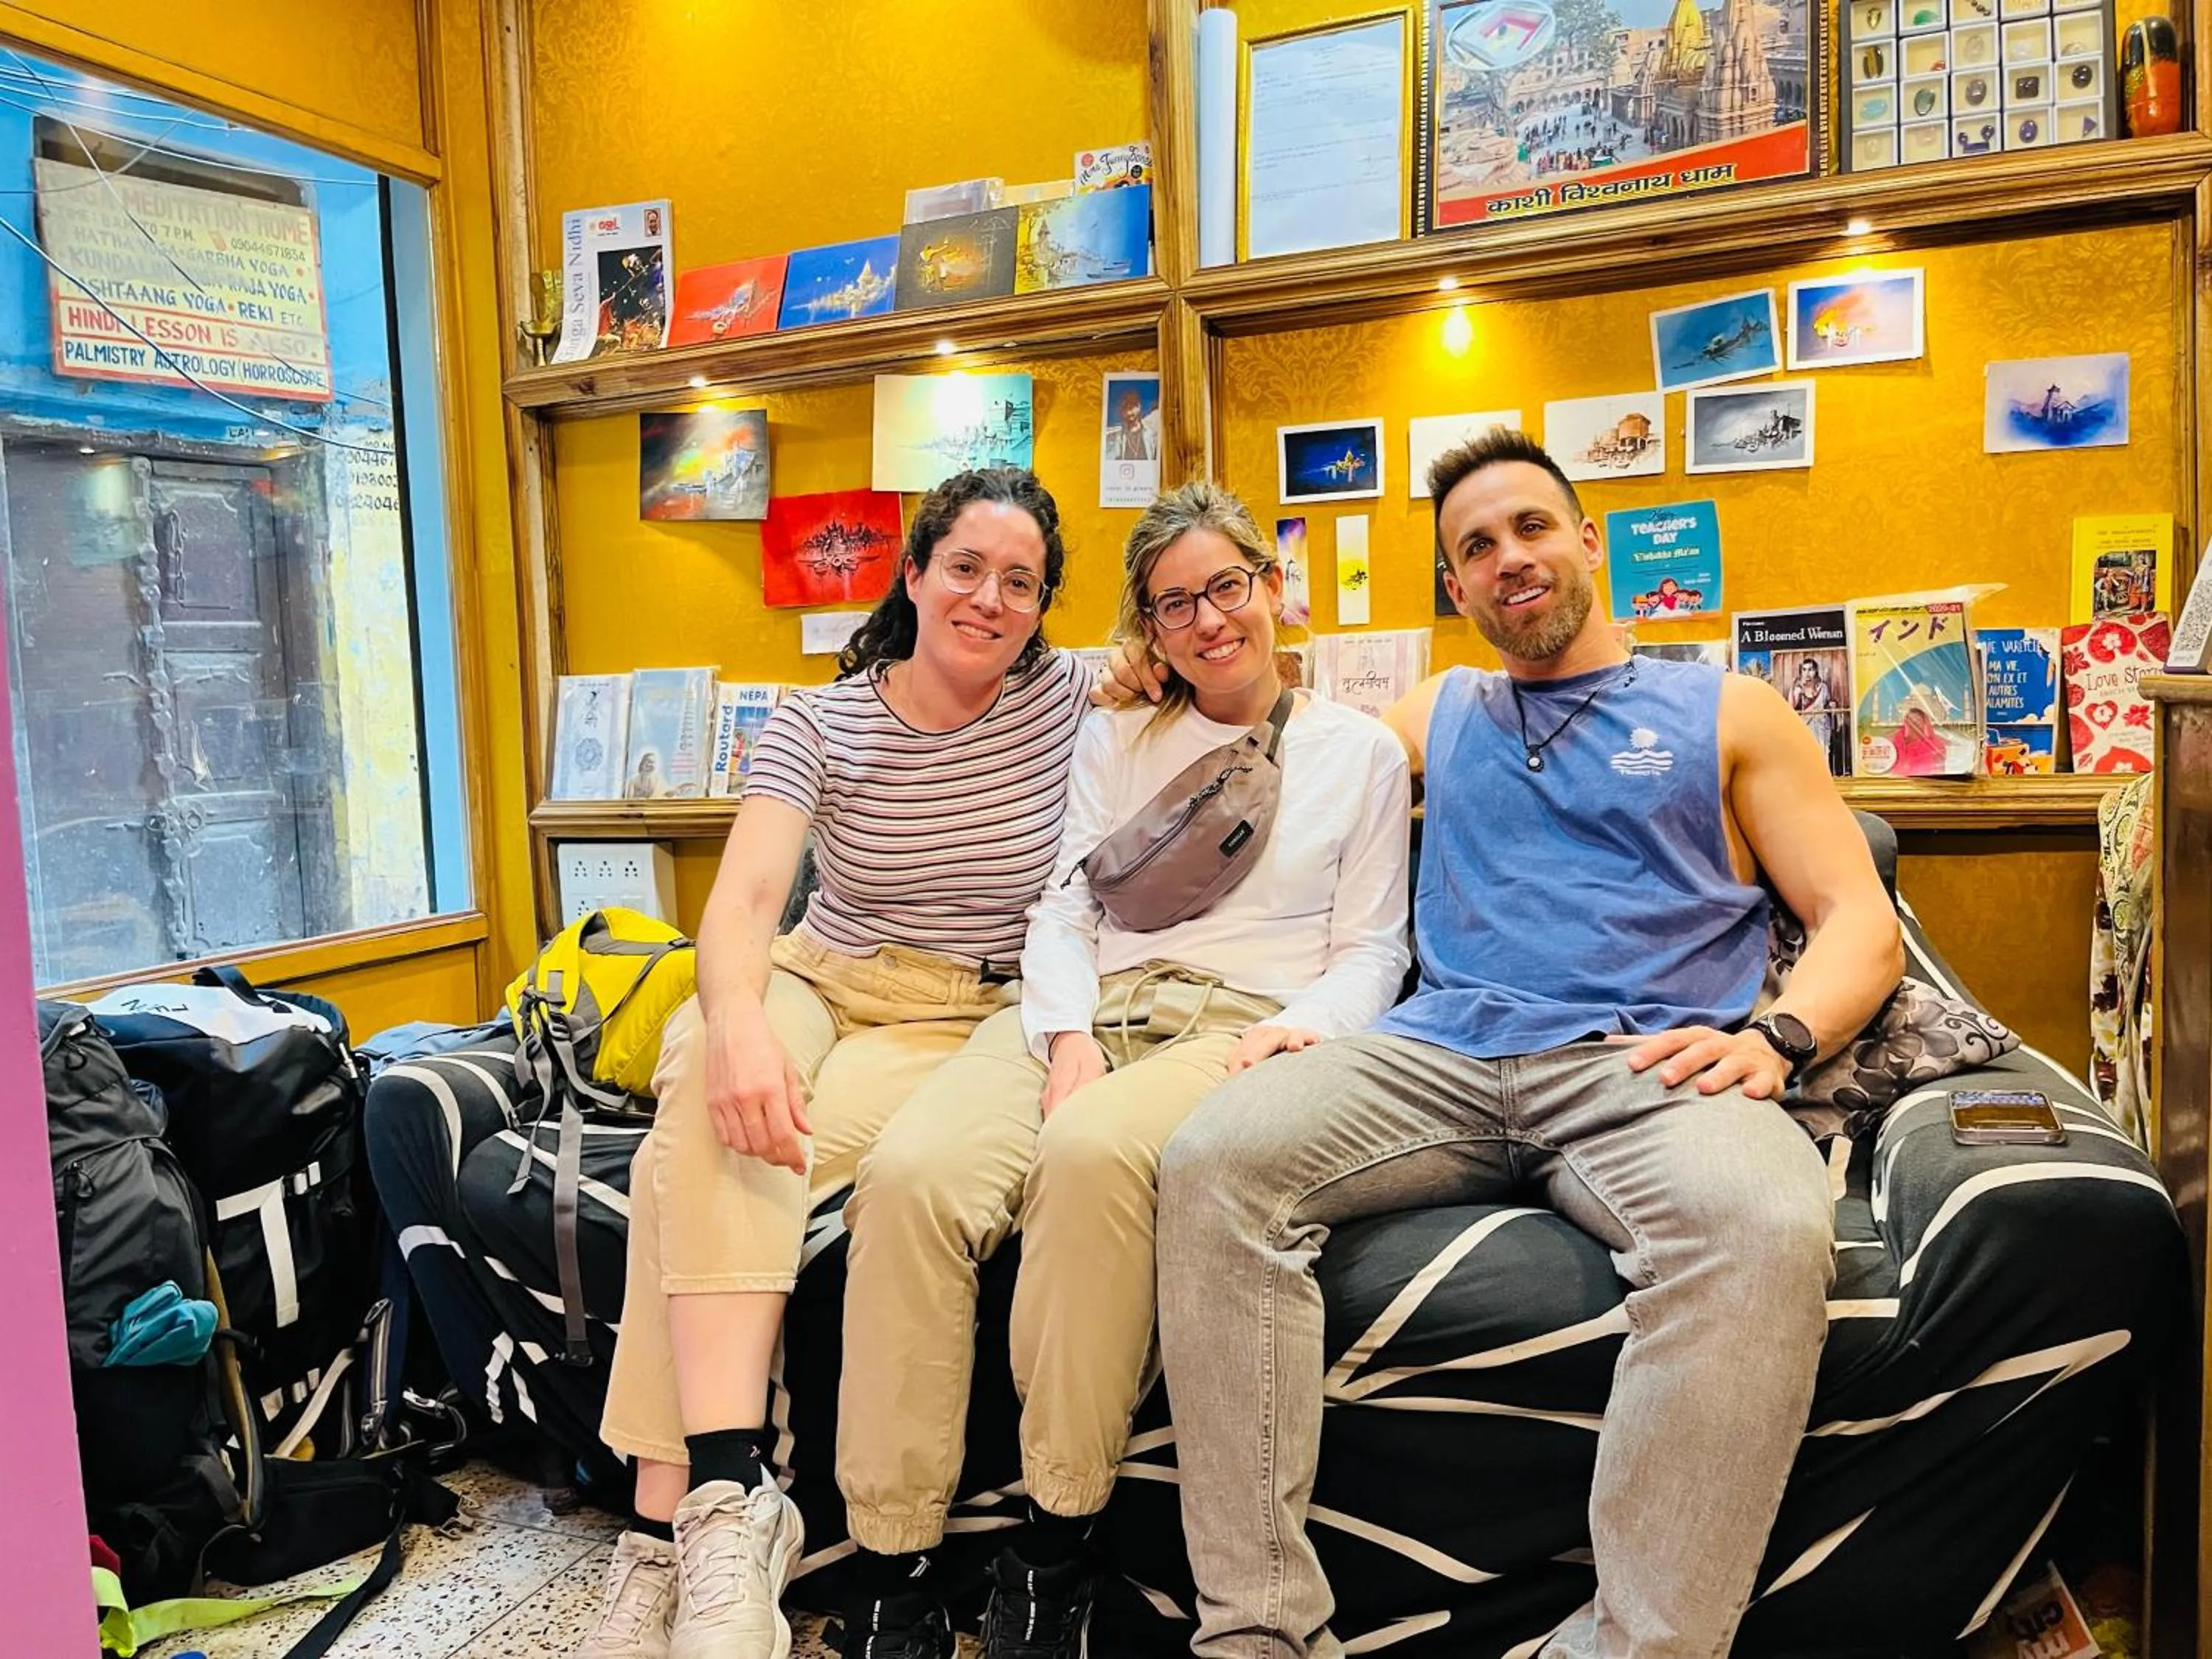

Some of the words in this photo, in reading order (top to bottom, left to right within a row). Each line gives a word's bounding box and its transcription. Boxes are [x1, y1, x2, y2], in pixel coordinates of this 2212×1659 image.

[1487, 188, 1552, 214] काशी
[1680, 164, 1736, 184] धाम
[122, 187, 249, 234] MEDITATION
[258, 215, 308, 246] HOME
[567, 218, 584, 267] Nidhi
[249, 258, 290, 278] YOGA
[268, 281, 307, 304] YOGA
[182, 291, 226, 313] YOGA
[237, 301, 274, 322] REKI
[68, 306, 122, 333] HINDI
[131, 314, 212, 344] LESSON
[220, 327, 238, 347] IS
[65, 341, 145, 366] PALMISTRY
[154, 349, 236, 377] ASTROLOGY
[1652, 532, 1678, 545] DAY
[1741, 630, 1751, 643] A
[1754, 627, 1806, 642] Bloomed
[1807, 626, 1843, 640] Woman
[1869, 616, 1949, 644] インド
[1989, 660, 2002, 672] MA
[1986, 672, 2000, 684] ON
[2003, 672, 2014, 684] EX
[2017, 672, 2028, 684] ET
[2086, 672, 2118, 691] Love
[740, 691, 773, 701] NEPA
[1989, 684, 2018, 696] AUTRES
[715, 706, 733, 772] Routard
